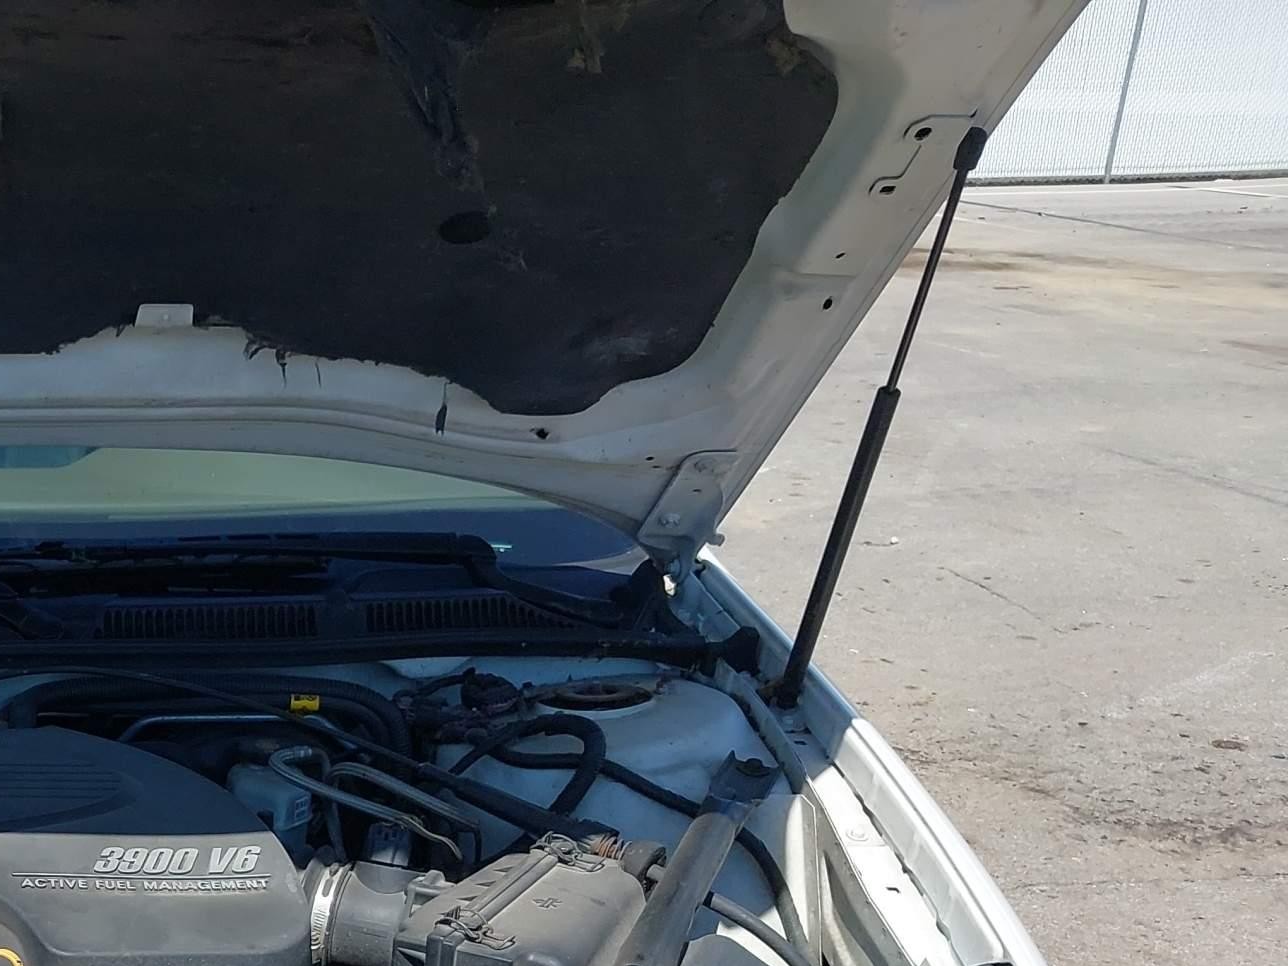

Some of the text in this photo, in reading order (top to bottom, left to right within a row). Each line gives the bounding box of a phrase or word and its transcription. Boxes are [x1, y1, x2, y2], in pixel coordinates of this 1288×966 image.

[94, 845, 261, 875] 3900 V6
[21, 877, 269, 892] ACTIVE FUEL MANAGEMENT
